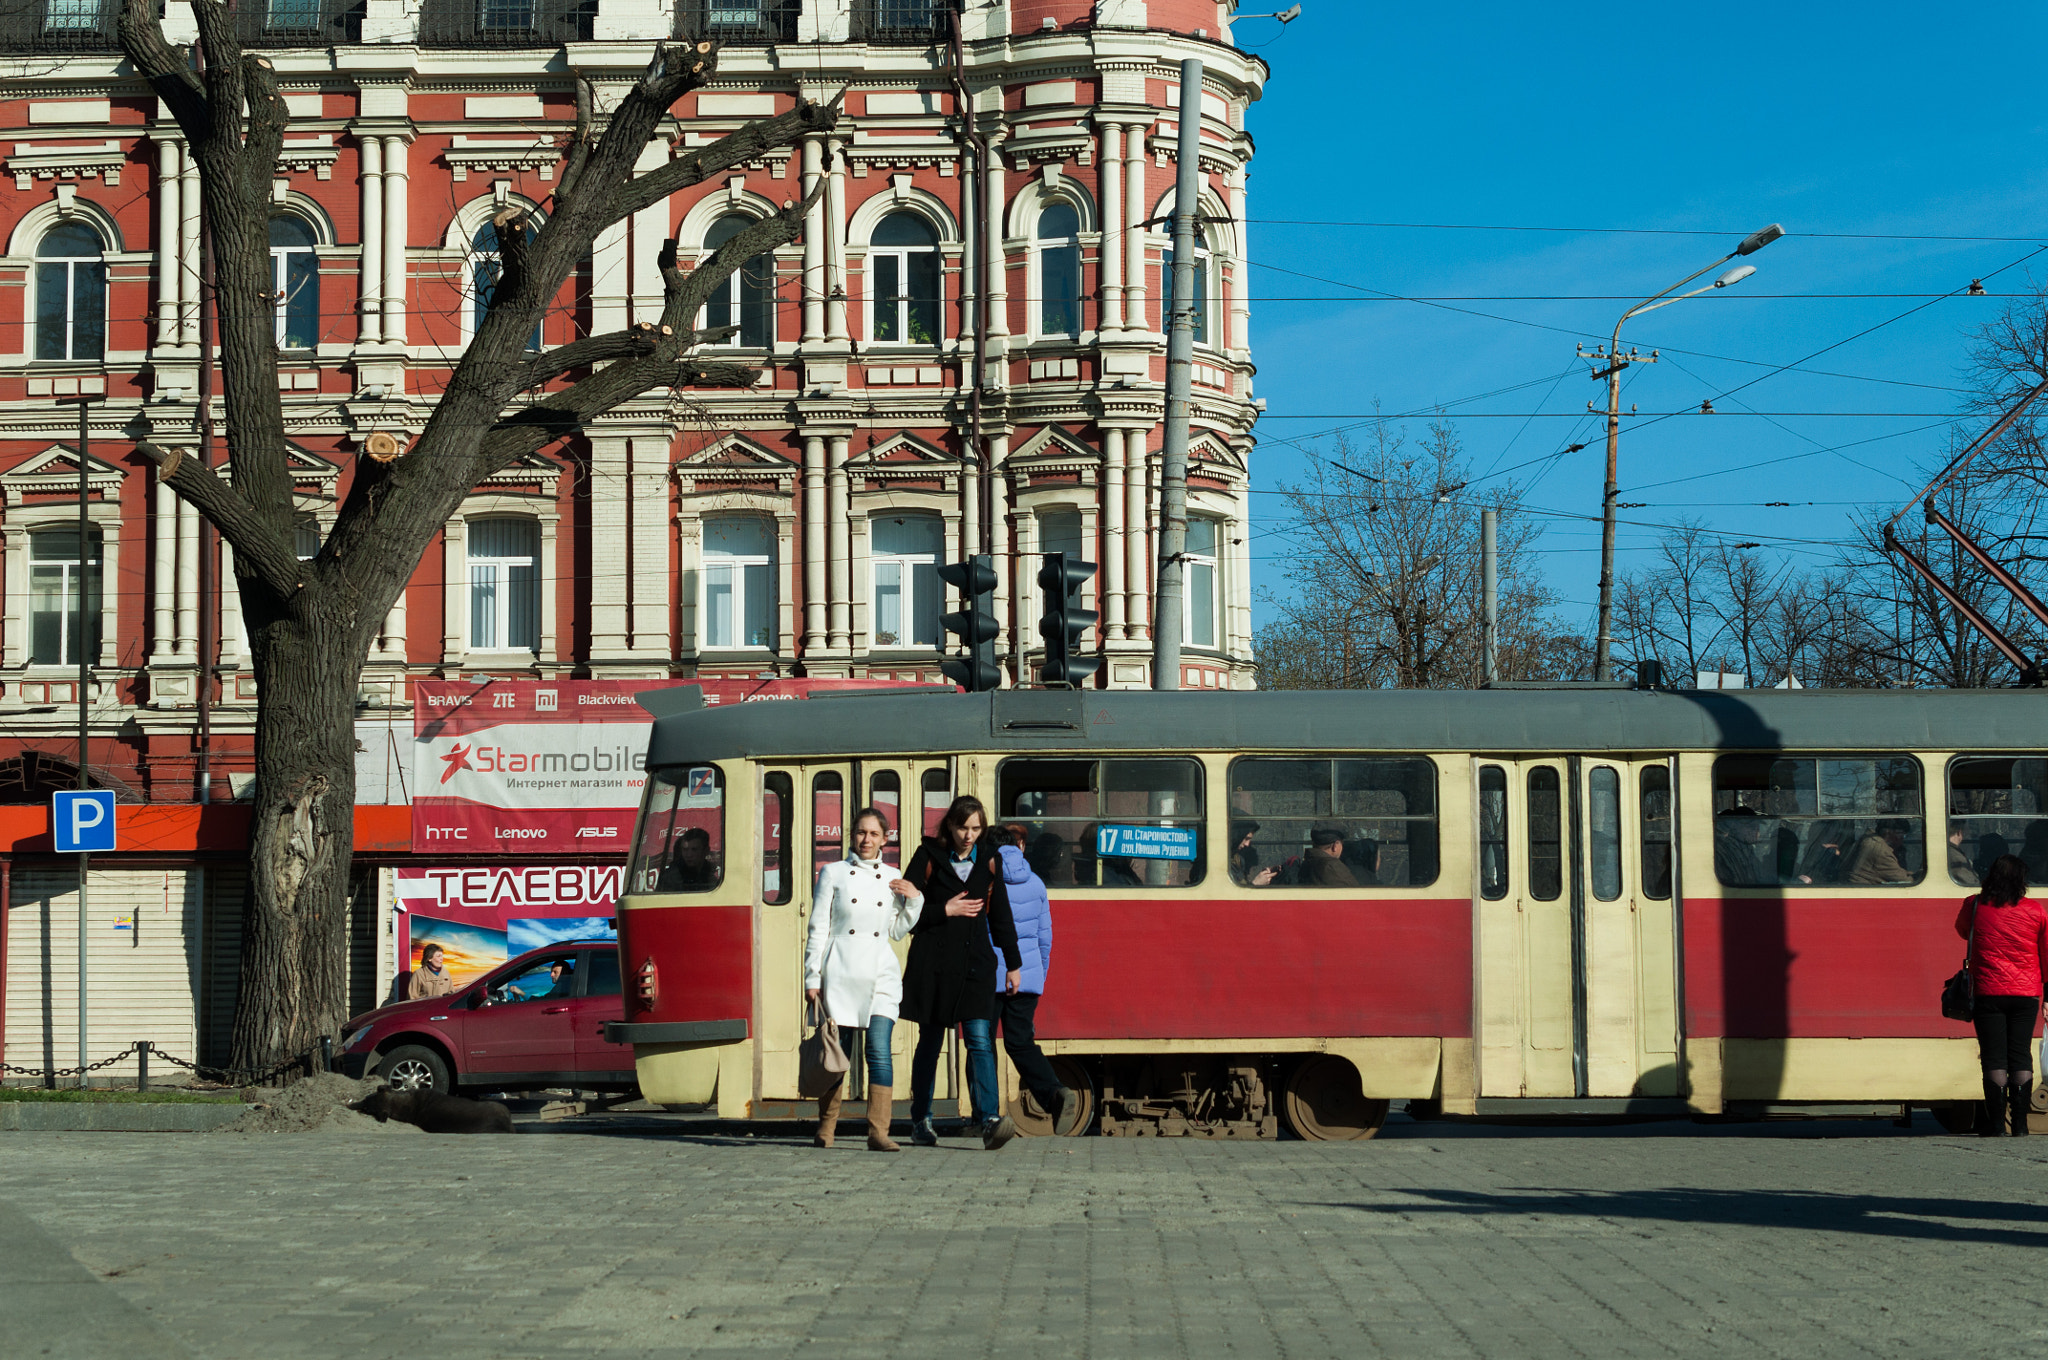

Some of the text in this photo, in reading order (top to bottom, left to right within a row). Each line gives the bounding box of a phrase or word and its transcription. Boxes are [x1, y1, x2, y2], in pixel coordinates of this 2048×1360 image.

[428, 695, 473, 706] BRAVIS
[493, 693, 515, 708] ZTE
[476, 746, 647, 772] Starmobile
[507, 778, 647, 790] Интернет магазин мо
[494, 827, 547, 839] Lenovo
[575, 827, 617, 837] ASUS
[1100, 828, 1118, 853] 17
[427, 867, 622, 905] ТЕЛЕВИ
